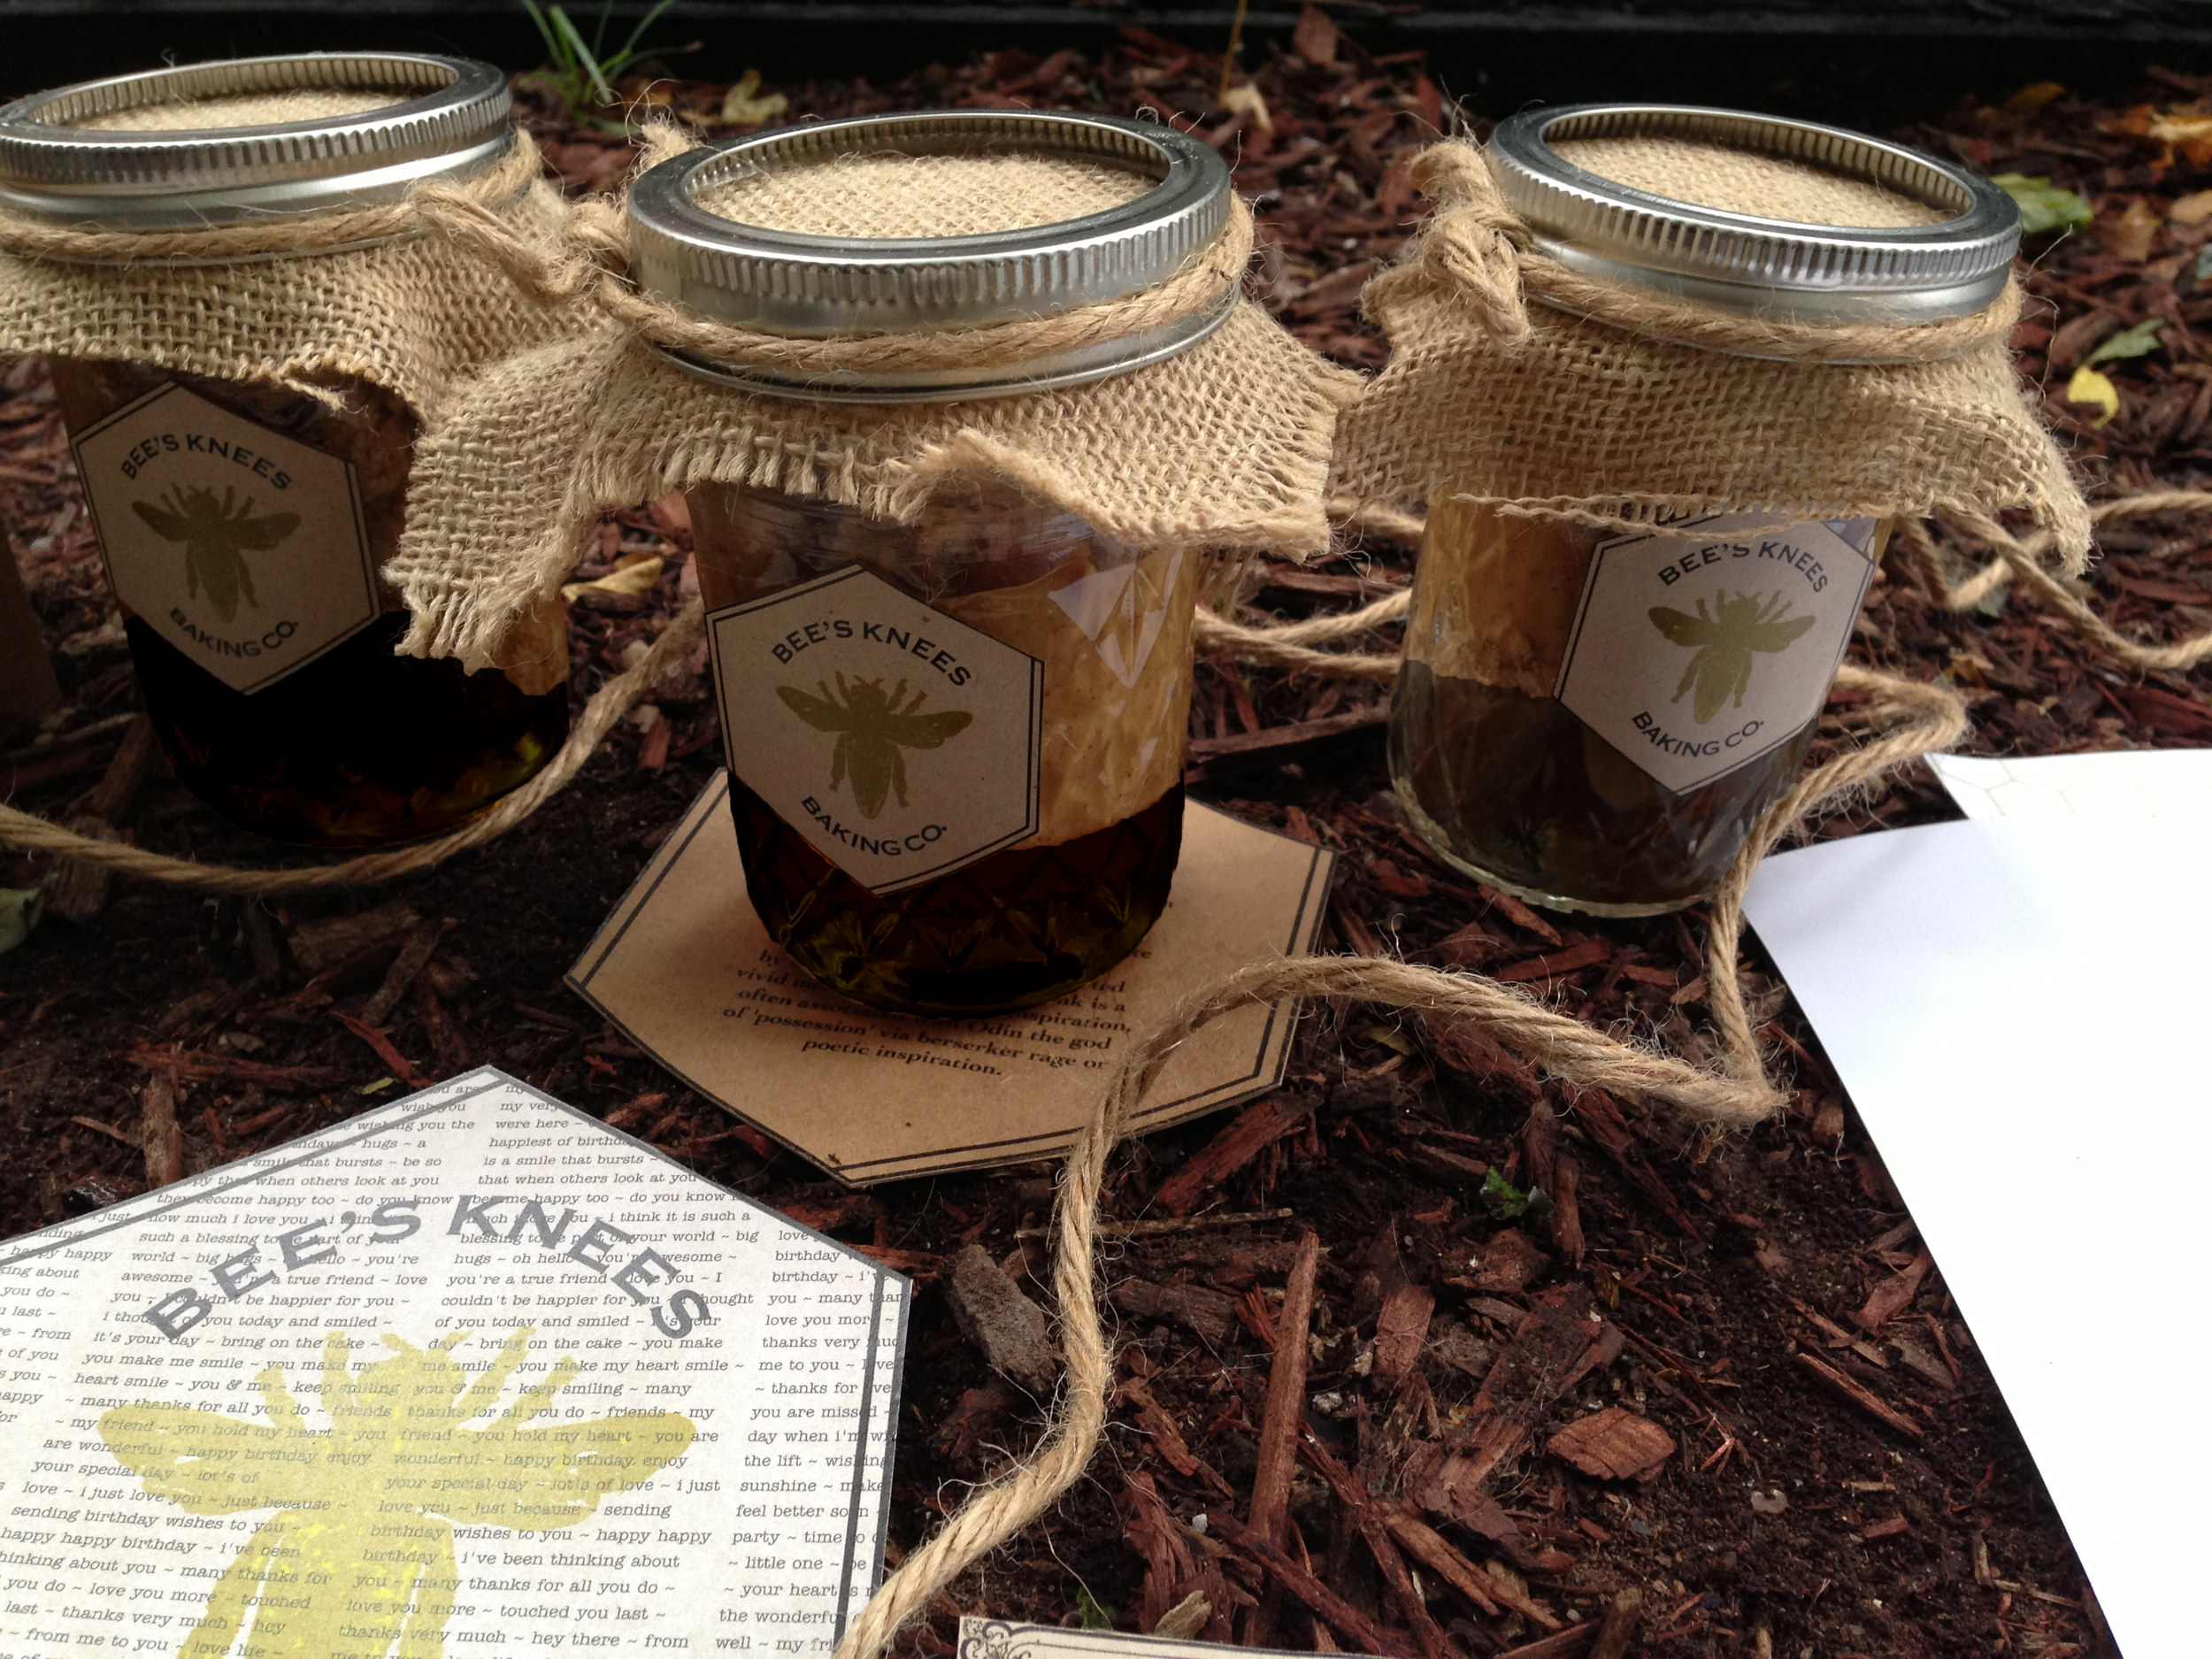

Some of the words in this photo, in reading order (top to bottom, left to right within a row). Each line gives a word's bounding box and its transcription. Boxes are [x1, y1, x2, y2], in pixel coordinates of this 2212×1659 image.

[120, 434, 180, 480] BEE'S
[186, 434, 293, 490] KNEES
[1657, 541, 1750, 587] BEE'S
[1758, 541, 1828, 593] KNEES
[170, 608, 262, 658] BAKING
[771, 619, 854, 665] BEE'S
[863, 621, 972, 687] KNEES
[1632, 711, 1720, 758] BAKING
[801, 796, 902, 856] BAKING
[737, 968, 789, 985] vivid
[1092, 997, 1106, 1010] is
[1114, 1003, 1125, 1012] a
[738, 988, 792, 1007] often
[968, 1020, 1022, 1039] Odin
[1031, 1029, 1064, 1044] the
[1069, 1037, 1113, 1050] god
[723, 1007, 750, 1018] of
[753, 1010, 875, 1035] 'possession'
[881, 1028, 910, 1042] via
[918, 1032, 1024, 1058] berserker
[1029, 1053, 1077, 1069] rage
[802, 1039, 870, 1056] poetic
[876, 1045, 1002, 1076] inspiration.
[535, 1119, 569, 1128] here
[362, 1140, 397, 1150] hugs
[488, 1138, 552, 1148] happiest
[335, 1157, 382, 1167] bursts
[516, 1156, 556, 1165] smile
[562, 1156, 592, 1164] that
[597, 1155, 643, 1164] bursts
[257, 1176, 295, 1186] when
[301, 1177, 349, 1186] others
[355, 1176, 386, 1186] look
[411, 1178, 439, 1187] you
[479, 1175, 509, 1185] that
[516, 1175, 554, 1184] when
[560, 1174, 608, 1184] others
[613, 1173, 644, 1183] look
[257, 1195, 306, 1207] happy
[535, 1194, 581, 1205] happy
[587, 1194, 609, 1202] too
[651, 1194, 680, 1203] you
[686, 1192, 726, 1202] know
[185, 1214, 227, 1223] much
[243, 1214, 275, 1224] love
[620, 1212, 660, 1222] think
[701, 1211, 735, 1221] such
[139, 1233, 174, 1241] such
[196, 1233, 259, 1246] blessing
[672, 1231, 715, 1241] world
[736, 1231, 759, 1243] big
[132, 1252, 175, 1262] world
[196, 1253, 220, 1265] big
[365, 1254, 419, 1266] you're
[454, 1254, 491, 1266] hugs
[776, 1250, 841, 1263] birthday
[35, 1267, 79, 1278] about
[142, 1199, 421, 1342] BEE'S
[446, 1194, 712, 1341] KNEES
[121, 1272, 193, 1283] awesome
[288, 1275, 320, 1285] true
[326, 1275, 374, 1285] friend
[396, 1275, 427, 1285] love
[446, 1274, 500, 1286] you're
[521, 1275, 554, 1284] true
[559, 1273, 607, 1284] friend
[772, 1271, 839, 1284] birthday
[269, 1295, 332, 1308] happier
[336, 1295, 361, 1306] for
[364, 1298, 394, 1308] you
[442, 1295, 506, 1306] couldn't
[536, 1294, 597, 1308] happier
[818, 1294, 863, 1305] many
[239, 1316, 285, 1328] today
[288, 1317, 319, 1326] and
[324, 1317, 377, 1327] smiled
[451, 1317, 485, 1329] you
[492, 1317, 537, 1329] today
[541, 1316, 572, 1326] and
[577, 1316, 629, 1326] smiled
[765, 1315, 797, 1325] love
[802, 1317, 831, 1327] you
[32, 1328, 71, 1340] from
[93, 1332, 121, 1342] it's
[125, 1335, 165, 1345] your
[555, 1338, 580, 1348] the
[586, 1338, 622, 1348] cake
[679, 1337, 722, 1348] make
[763, 1337, 817, 1348] thanks
[824, 1339, 861, 1349] very
[81, 1355, 113, 1364] you
[119, 1355, 164, 1366] make
[199, 1358, 243, 1368] smile
[635, 1360, 679, 1371] heart
[685, 1360, 728, 1371] smile
[73, 1373, 119, 1385] heart
[124, 1377, 168, 1387] smile
[563, 1383, 624, 1397] smiling
[645, 1385, 692, 1396] many
[772, 1382, 827, 1394] thanks
[748, 1430, 778, 1445] day
[784, 1430, 828, 1442] when
[31, 1462, 73, 1472] your
[744, 1455, 771, 1466] the
[777, 1455, 802, 1466] lift
[22, 1481, 58, 1494] love
[740, 1479, 817, 1492] sunshine
[604, 1504, 672, 1519] sending
[736, 1504, 766, 1517] feel
[773, 1505, 824, 1517] better
[12, 1507, 81, 1523] sending
[84, 1509, 159, 1527] birthday
[166, 1516, 224, 1529] wishes
[453, 1527, 511, 1540] wishes
[539, 1530, 572, 1542] you
[595, 1528, 651, 1544] happy
[657, 1529, 712, 1545] happy
[732, 1530, 780, 1546] party
[804, 1531, 841, 1543] time
[60, 1532, 117, 1549] happy
[121, 1536, 197, 1555] birthday
[69, 1557, 119, 1571] about
[462, 1552, 496, 1564] i've
[503, 1553, 542, 1565] been
[551, 1554, 626, 1570] thinking
[631, 1555, 680, 1568] about
[745, 1556, 786, 1570] little
[88, 1583, 126, 1596] love
[470, 1578, 531, 1591] thanks
[537, 1578, 564, 1592] for
[569, 1579, 592, 1592] all
[740, 1585, 783, 1598] your
[789, 1583, 837, 1596] heart
[62, 1606, 125, 1622] thanks
[133, 1614, 173, 1628] very
[501, 1605, 569, 1618] touched
[616, 1606, 649, 1620] last
[25, 1628, 69, 1643] from
[456, 1630, 505, 1643] much
[531, 1632, 565, 1647] hey
[572, 1632, 619, 1647] there
[645, 1634, 688, 1648] from
